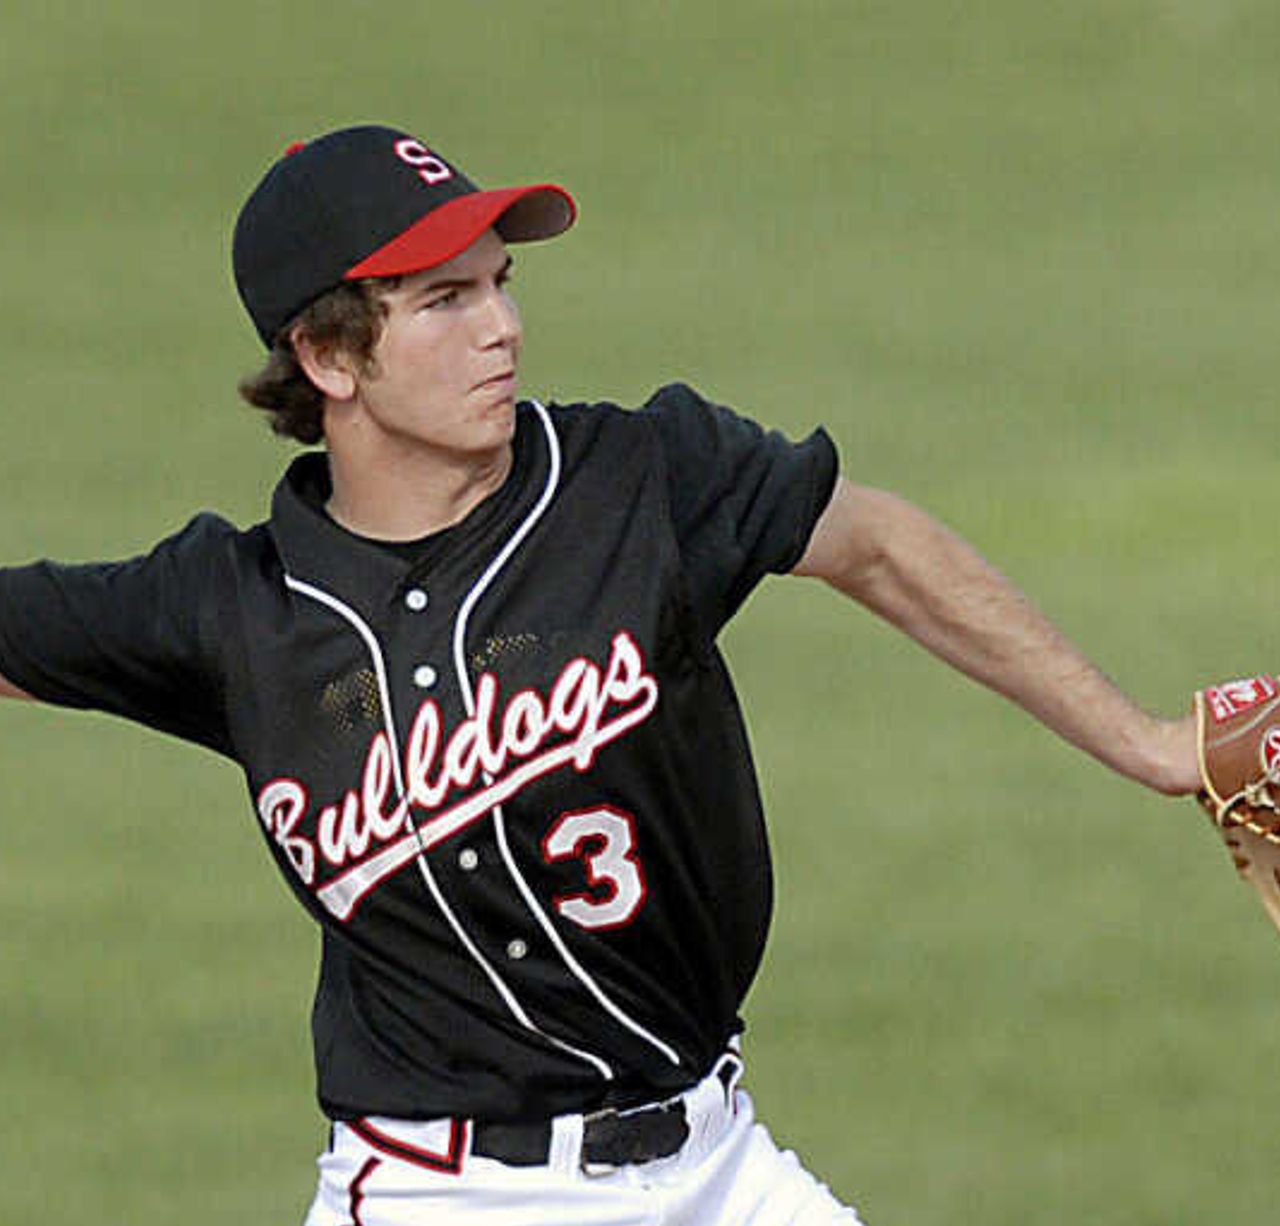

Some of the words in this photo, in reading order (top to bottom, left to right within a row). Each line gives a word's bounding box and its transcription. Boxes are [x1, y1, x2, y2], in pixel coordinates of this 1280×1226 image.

[394, 138, 452, 184] S
[258, 630, 658, 886] Bulldogs
[545, 805, 646, 930] 3
